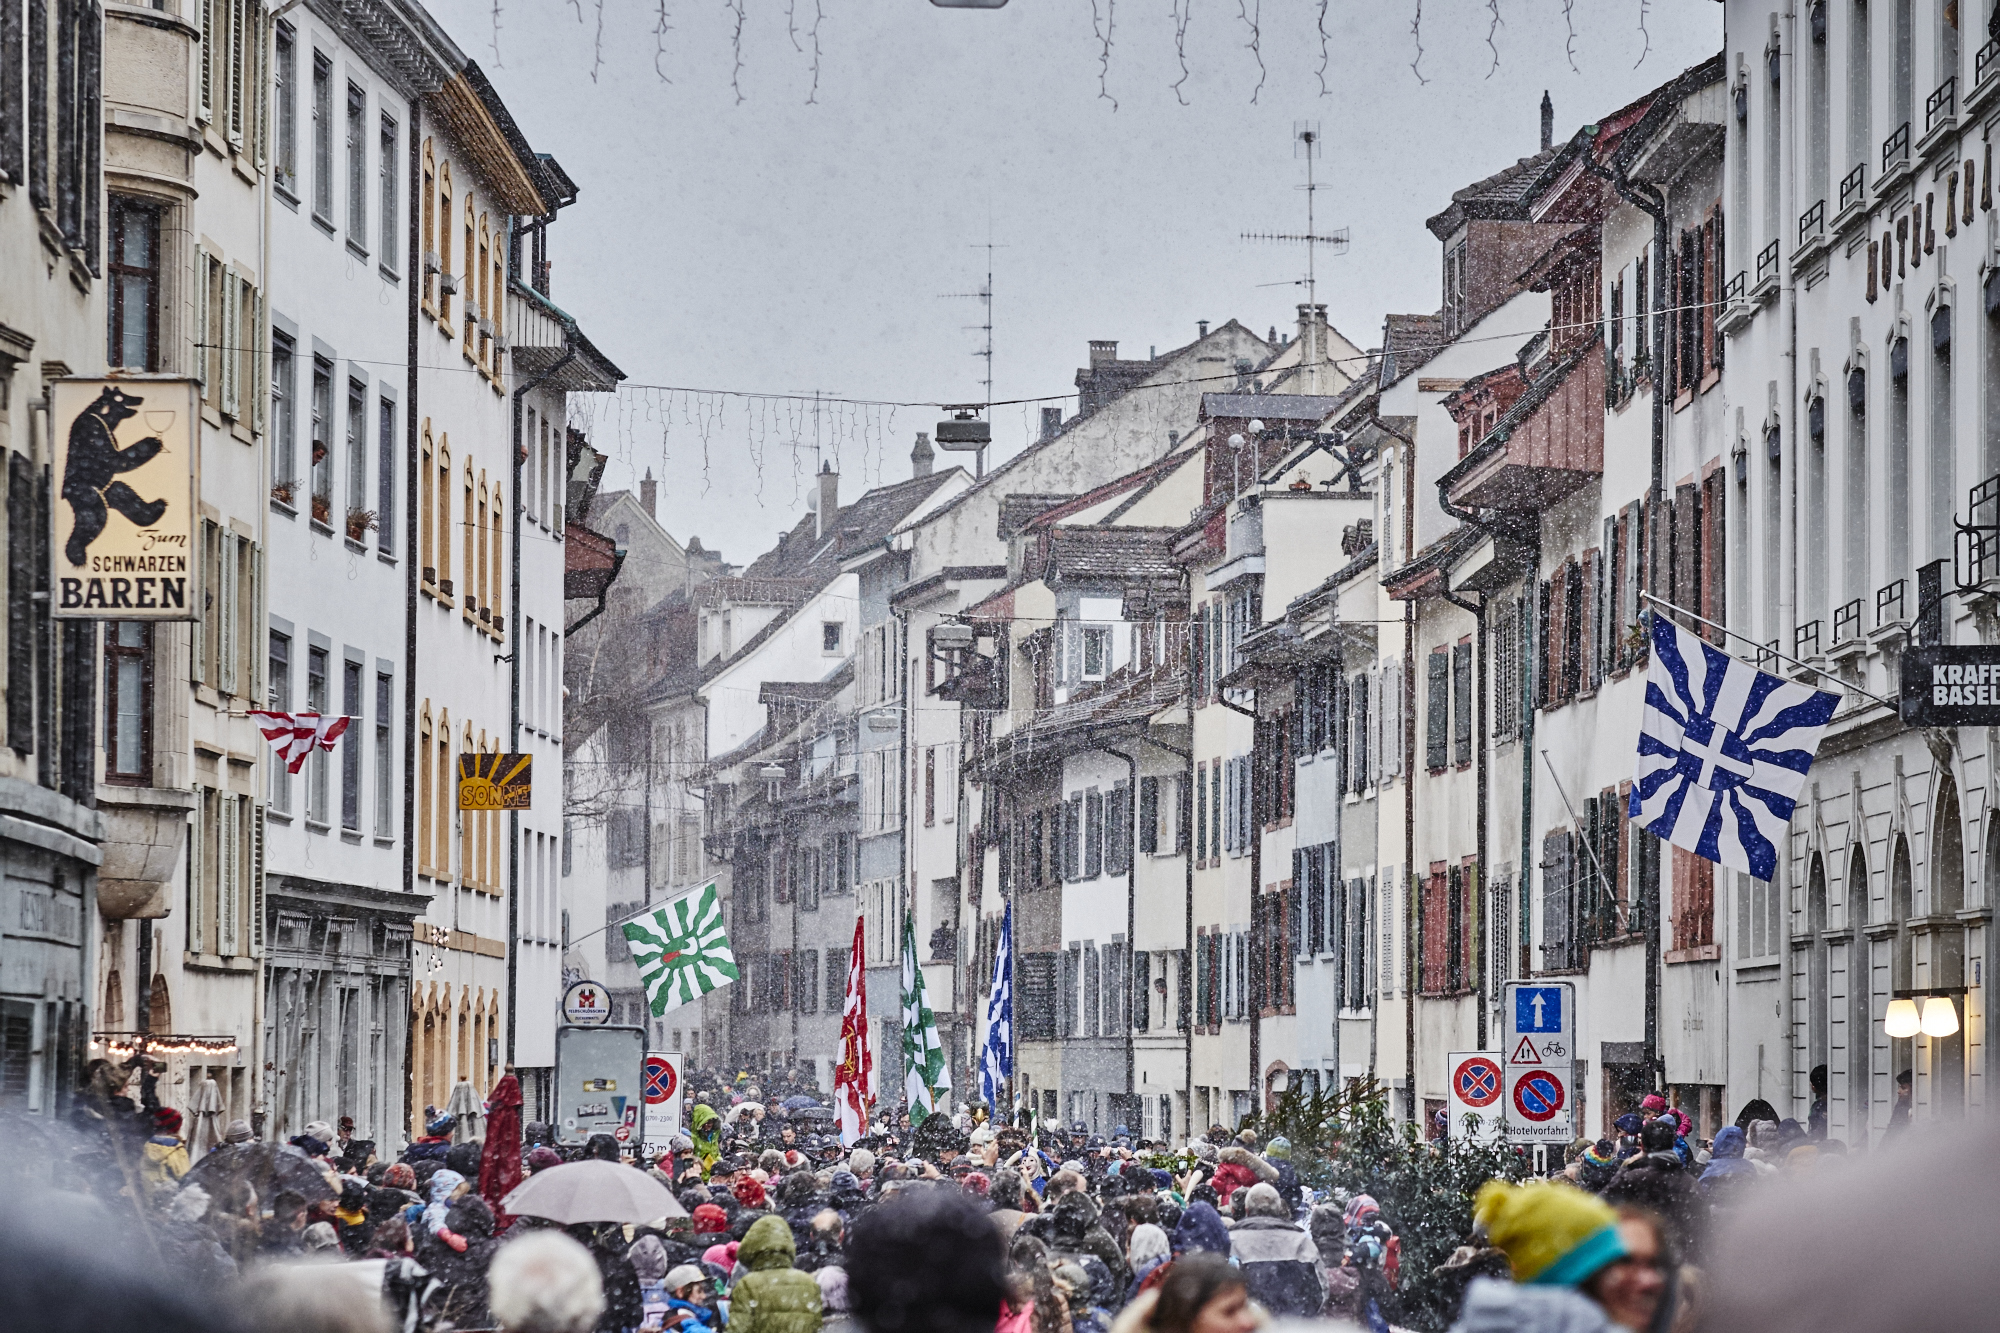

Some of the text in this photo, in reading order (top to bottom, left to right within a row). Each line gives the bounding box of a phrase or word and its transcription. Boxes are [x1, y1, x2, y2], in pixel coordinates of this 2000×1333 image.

[1866, 143, 2000, 305] HOTEL KRA
[137, 529, 186, 551] Zum
[93, 555, 186, 572] SCHWARZEN
[1932, 664, 2000, 685] KRAFF
[1932, 685, 2000, 706] BASEL
[461, 784, 529, 806] SONNE
[1510, 1125, 1569, 1136] Hotelvorfahrt
[642, 1142, 655, 1155] 75
